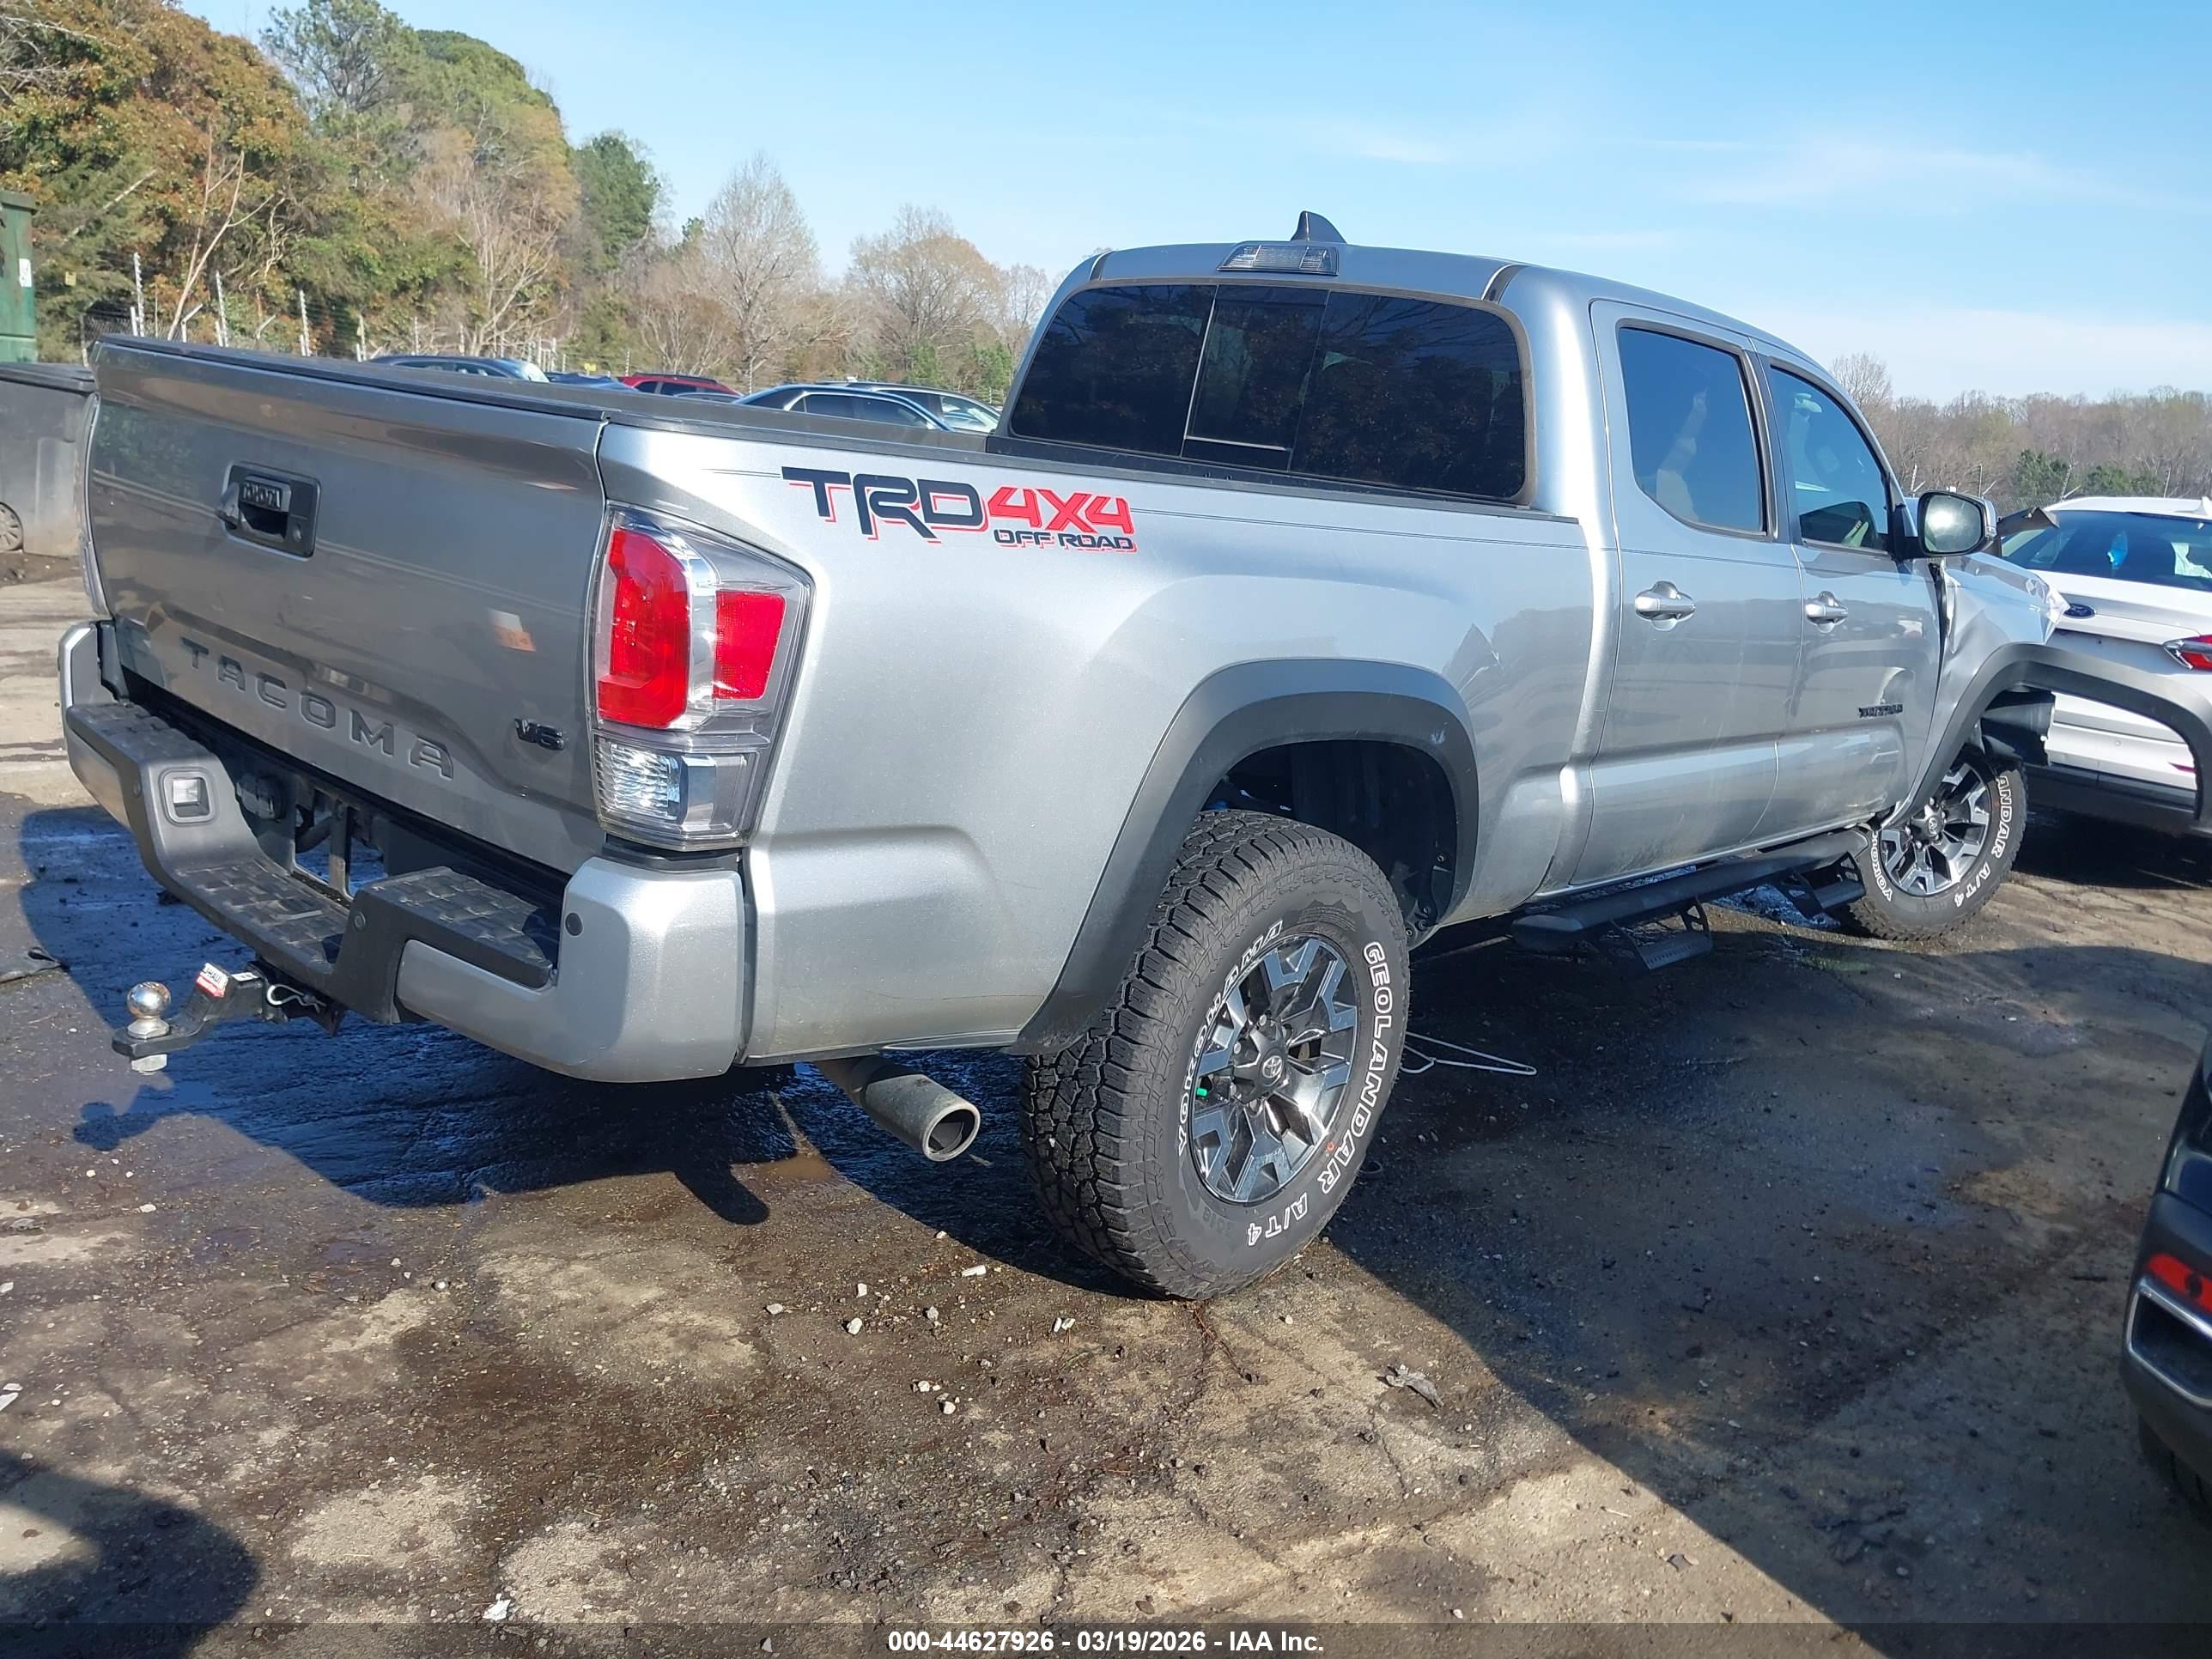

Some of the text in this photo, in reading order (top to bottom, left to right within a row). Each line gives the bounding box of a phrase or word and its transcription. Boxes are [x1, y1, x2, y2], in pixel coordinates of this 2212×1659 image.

[781, 466, 1134, 542] TRD 4X4
[994, 529, 1136, 552] OFF ROAD
[179, 636, 454, 780] TACOMA
[515, 717, 568, 750] V6
[1178, 920, 1283, 1157] YOKOHAMA
[1316, 941, 1394, 1194] GEOLANDAR
[1247, 1192, 1310, 1248] A/T4
